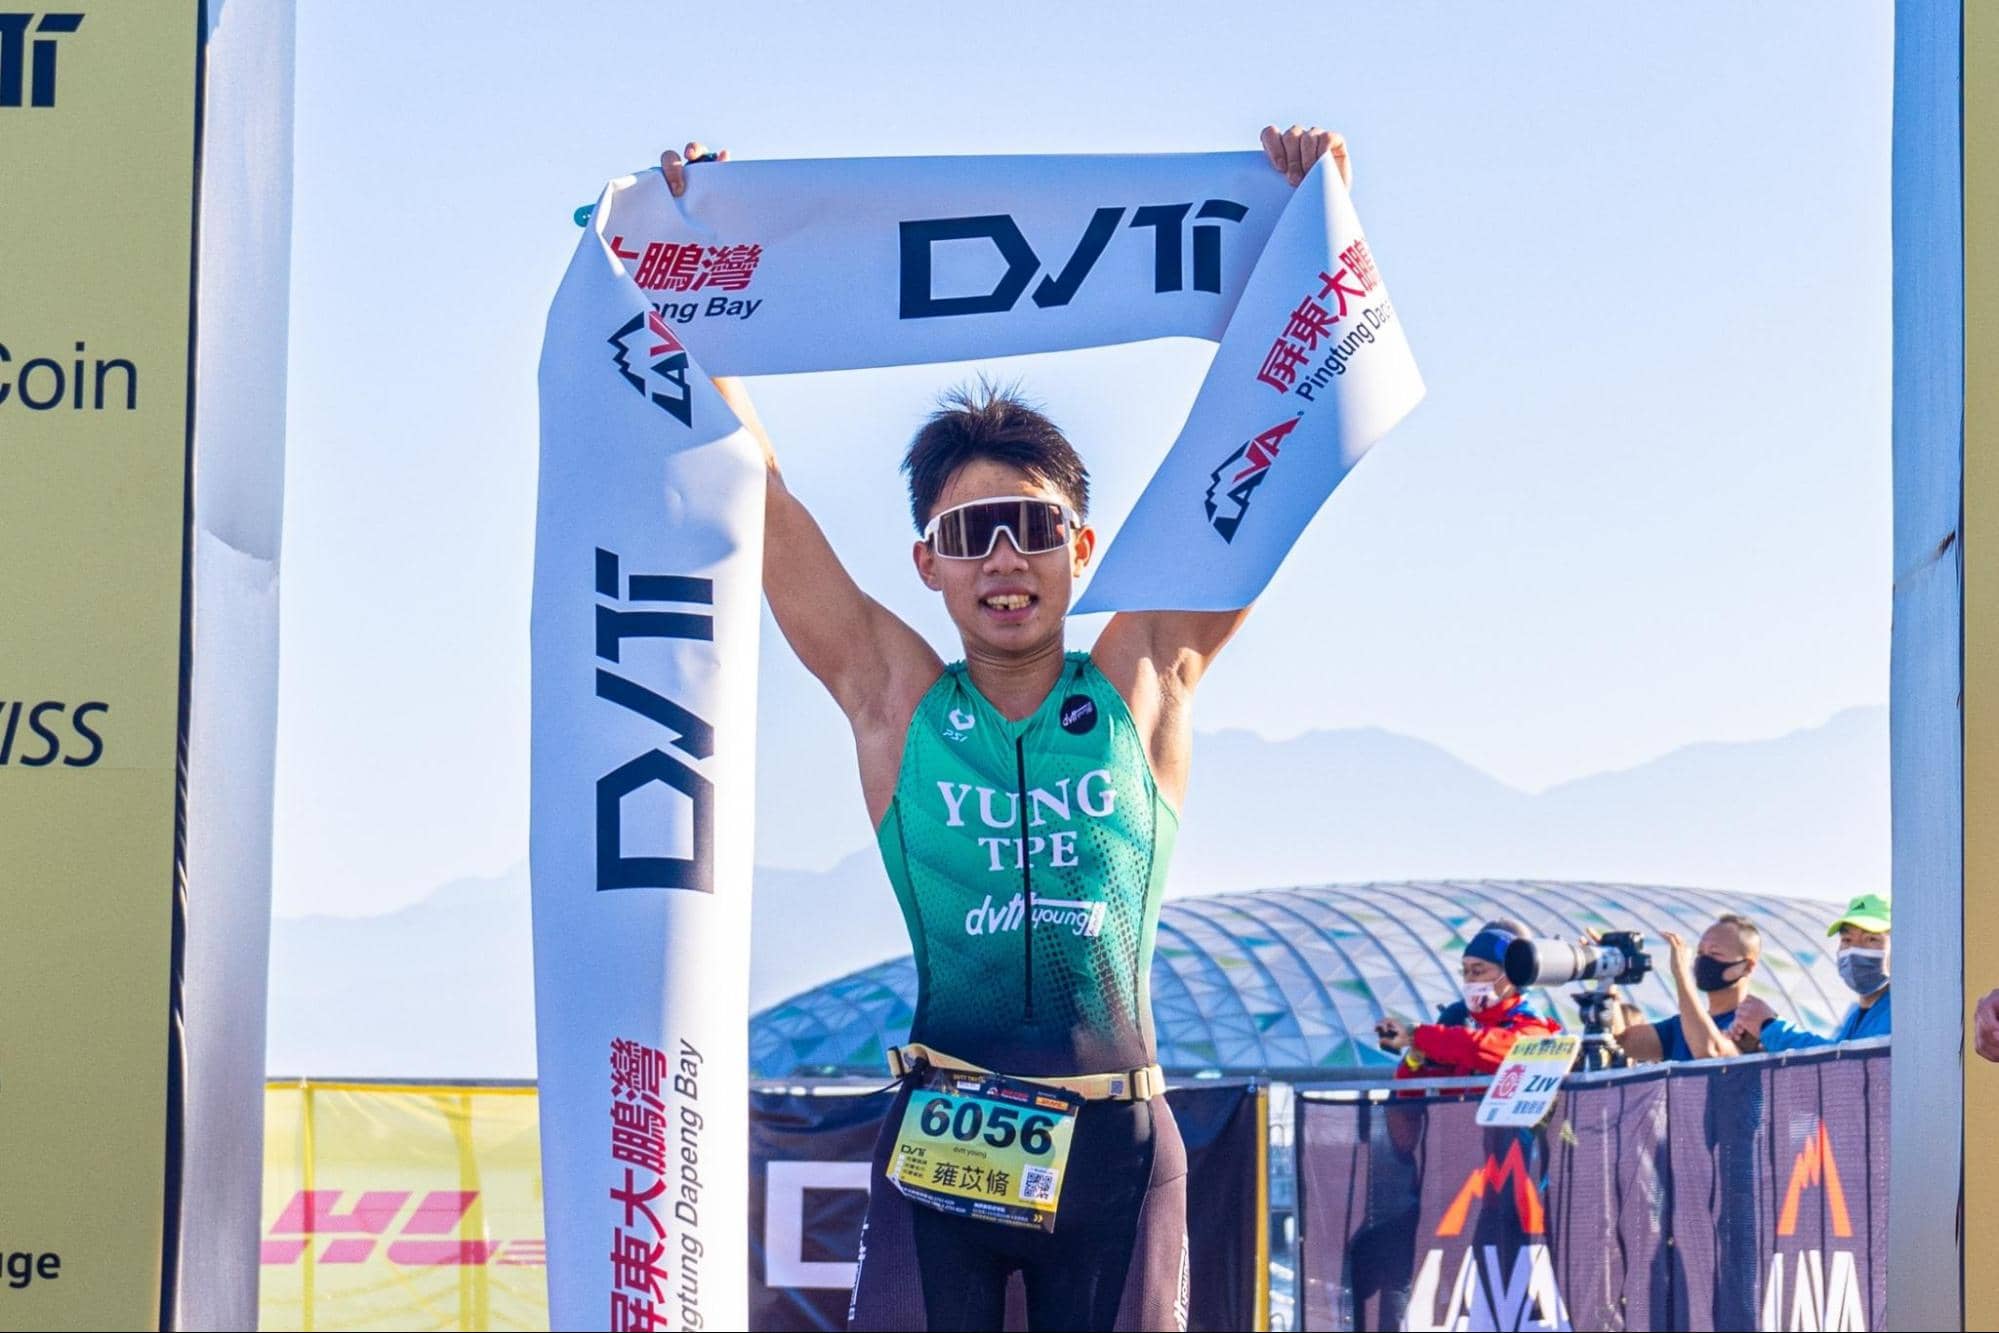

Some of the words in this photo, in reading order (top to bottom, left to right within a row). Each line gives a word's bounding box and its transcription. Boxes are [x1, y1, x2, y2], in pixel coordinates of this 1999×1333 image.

[704, 297, 763, 318] Bay
[1296, 321, 1375, 401] Pingtung
[1213, 417, 1301, 545] LAVA
[0, 701, 110, 767] ISS
[937, 769, 1117, 829] YUNG
[978, 831, 1079, 871] TPE
[1031, 908, 1088, 936] young
[674, 1038, 703, 1101] Bay
[921, 1098, 1055, 1156] 6056
[675, 1106, 703, 1227] Dapeng
[677, 1233, 703, 1332] gtung
